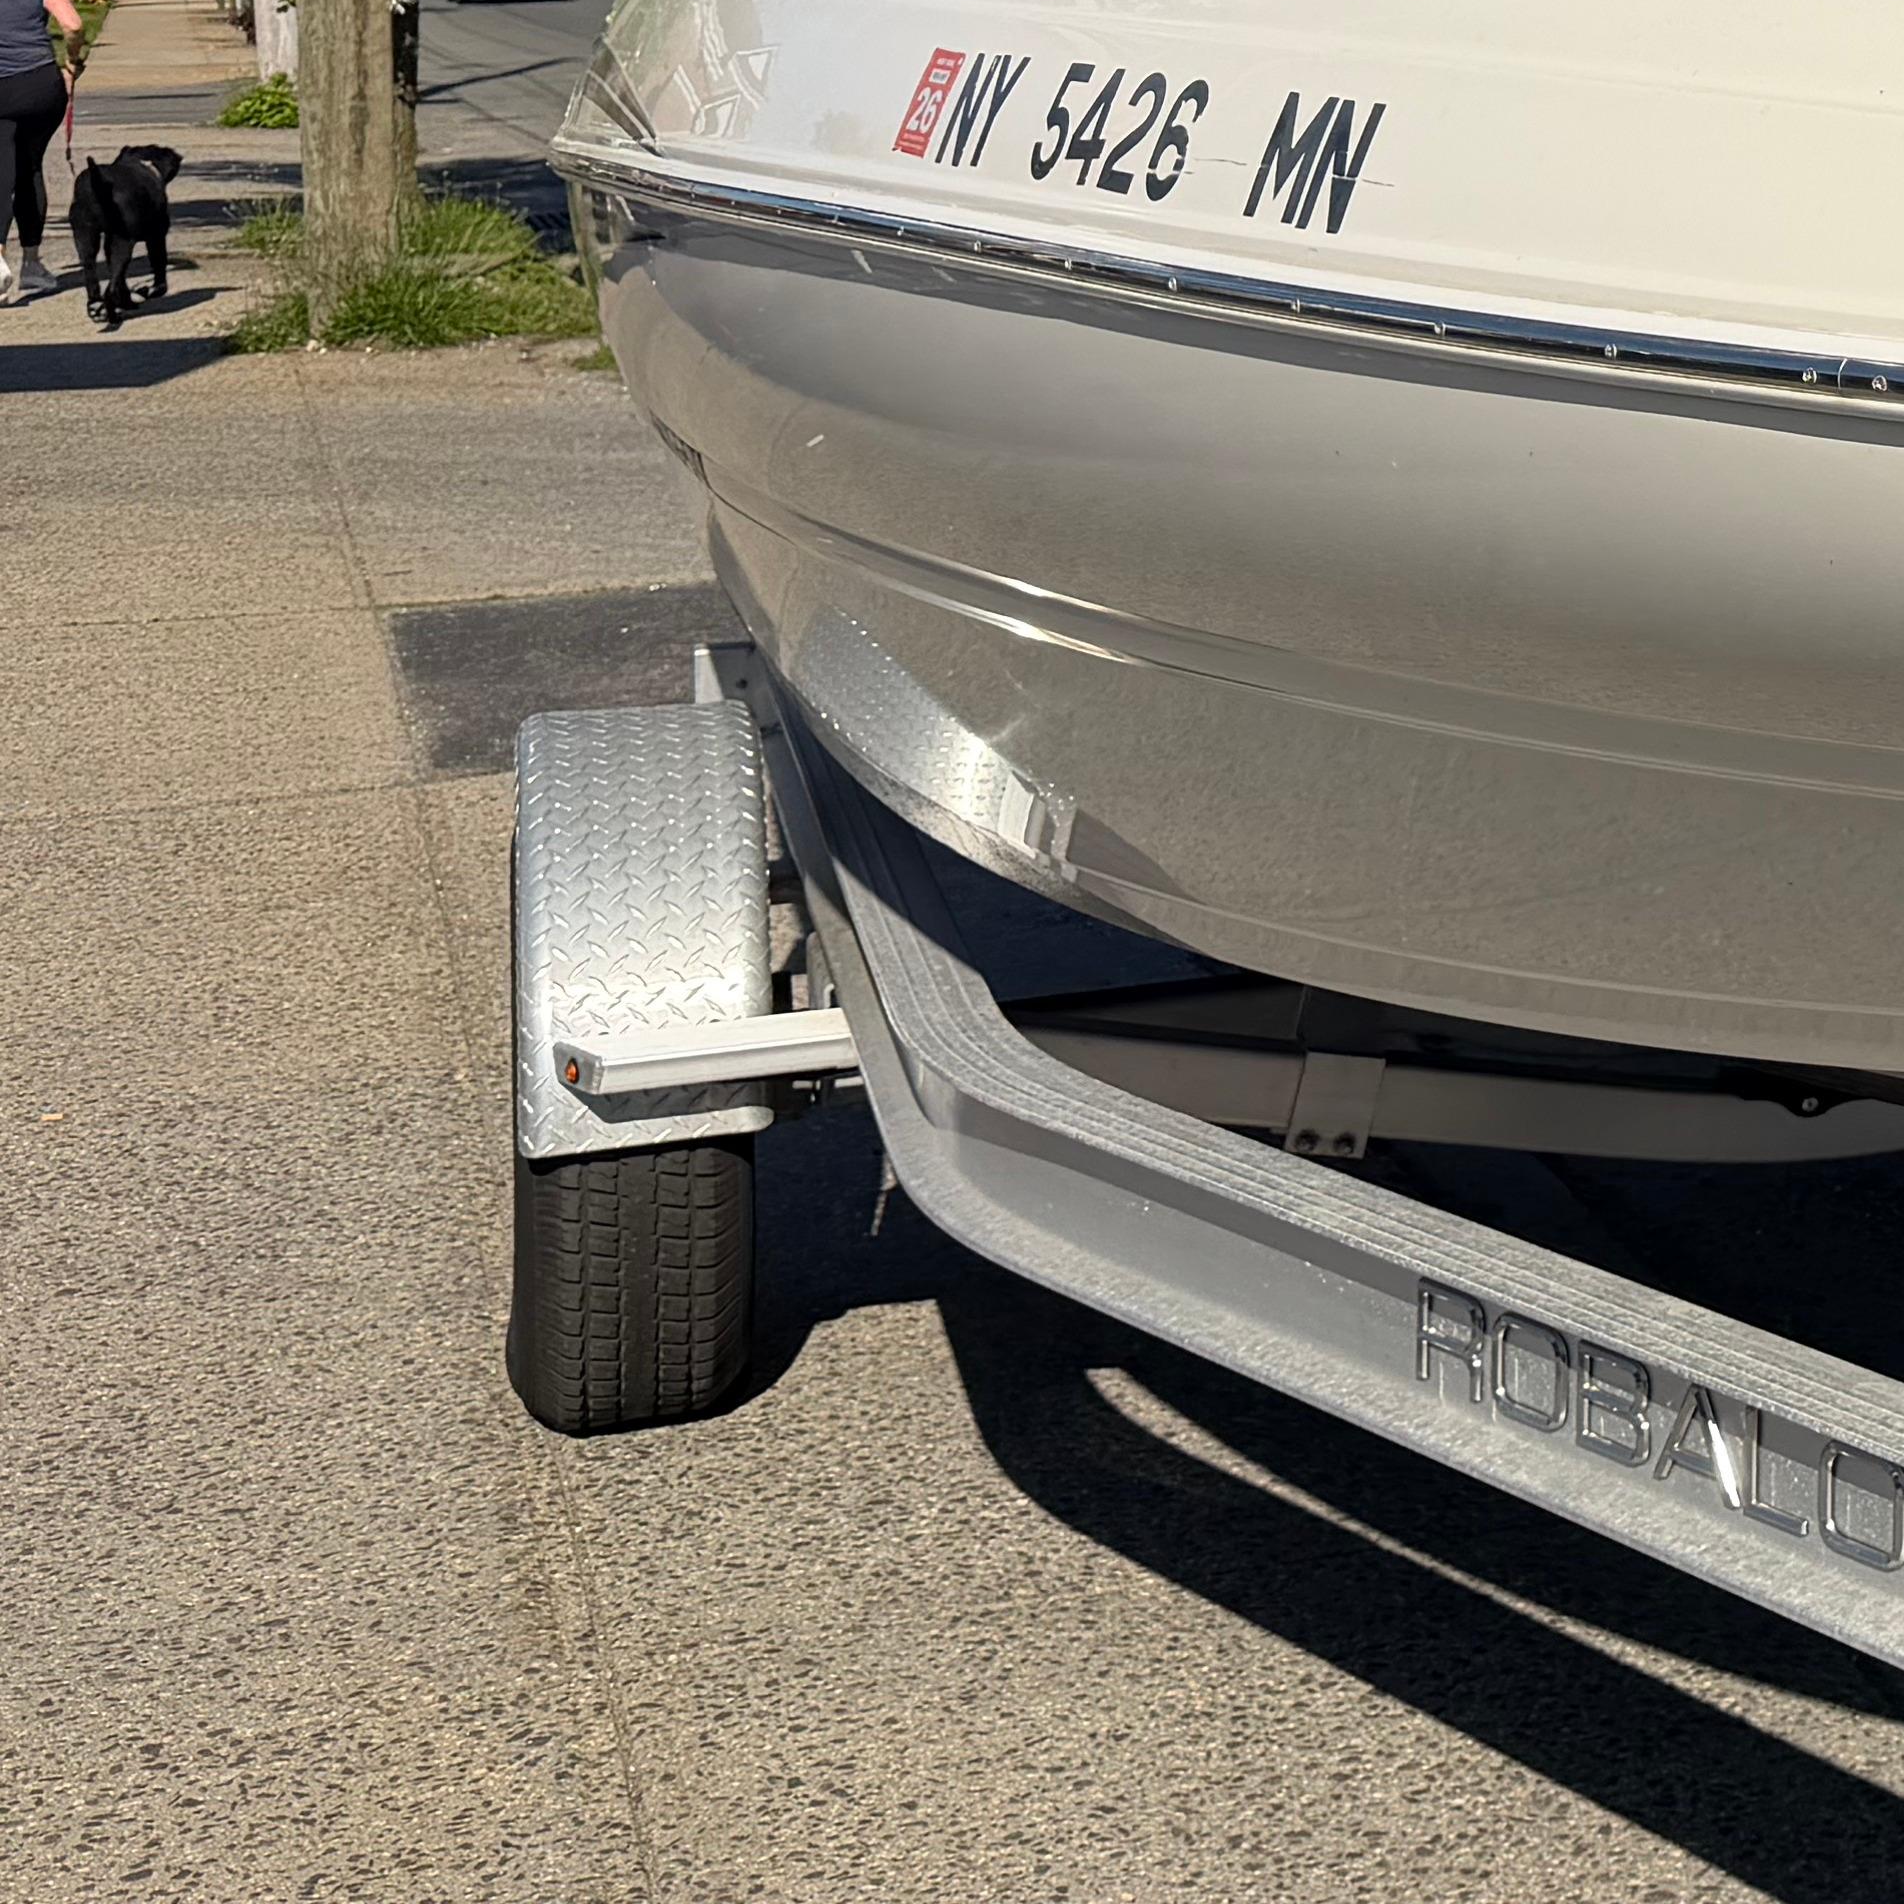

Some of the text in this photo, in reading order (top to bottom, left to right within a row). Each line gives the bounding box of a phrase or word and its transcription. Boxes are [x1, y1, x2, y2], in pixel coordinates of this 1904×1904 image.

[905, 86, 943, 134] 26
[934, 52, 1387, 234] NY 5426 MN
